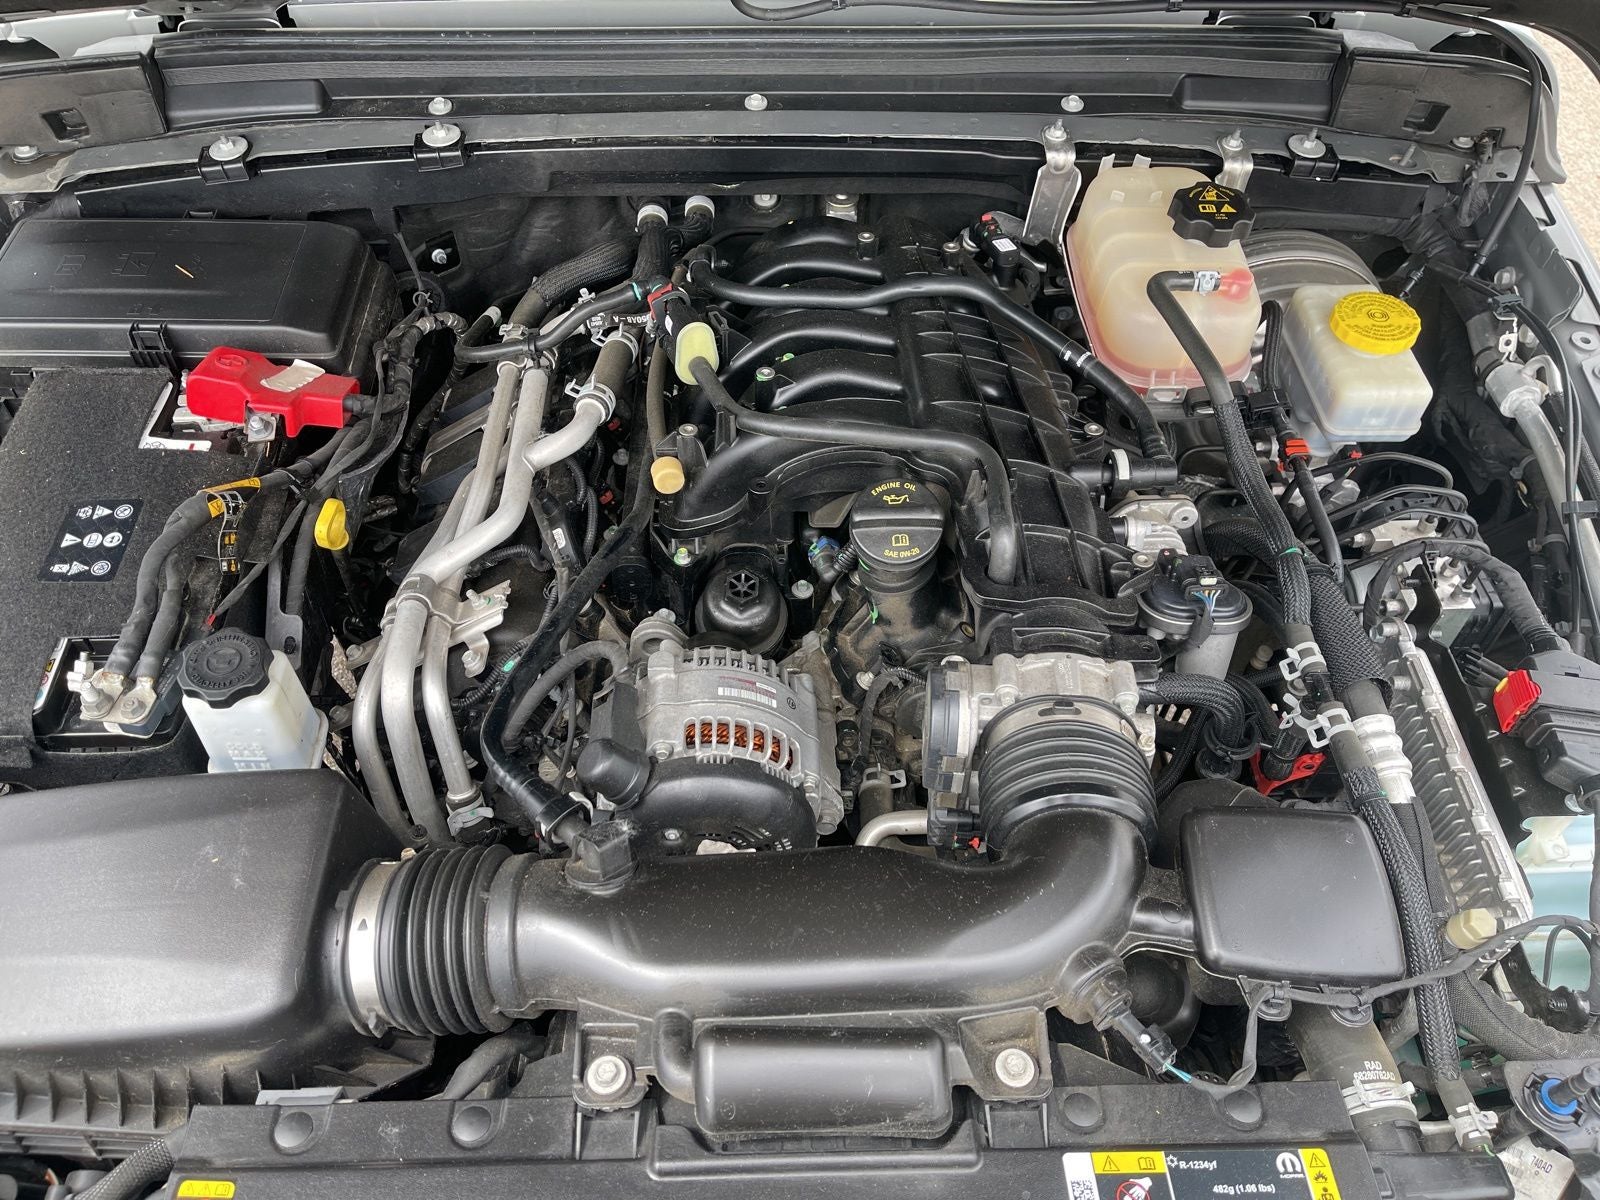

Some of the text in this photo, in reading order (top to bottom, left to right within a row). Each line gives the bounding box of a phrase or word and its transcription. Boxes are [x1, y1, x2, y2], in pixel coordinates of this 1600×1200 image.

[871, 482, 916, 495] ENGINE OIL
[884, 549, 898, 557] SAE
[1364, 1061, 1382, 1070] RAD
[1179, 1160, 1217, 1170] R-1234yf
[1213, 1184, 1235, 1195] 482g
[1258, 1183, 1276, 1194] lbs)
